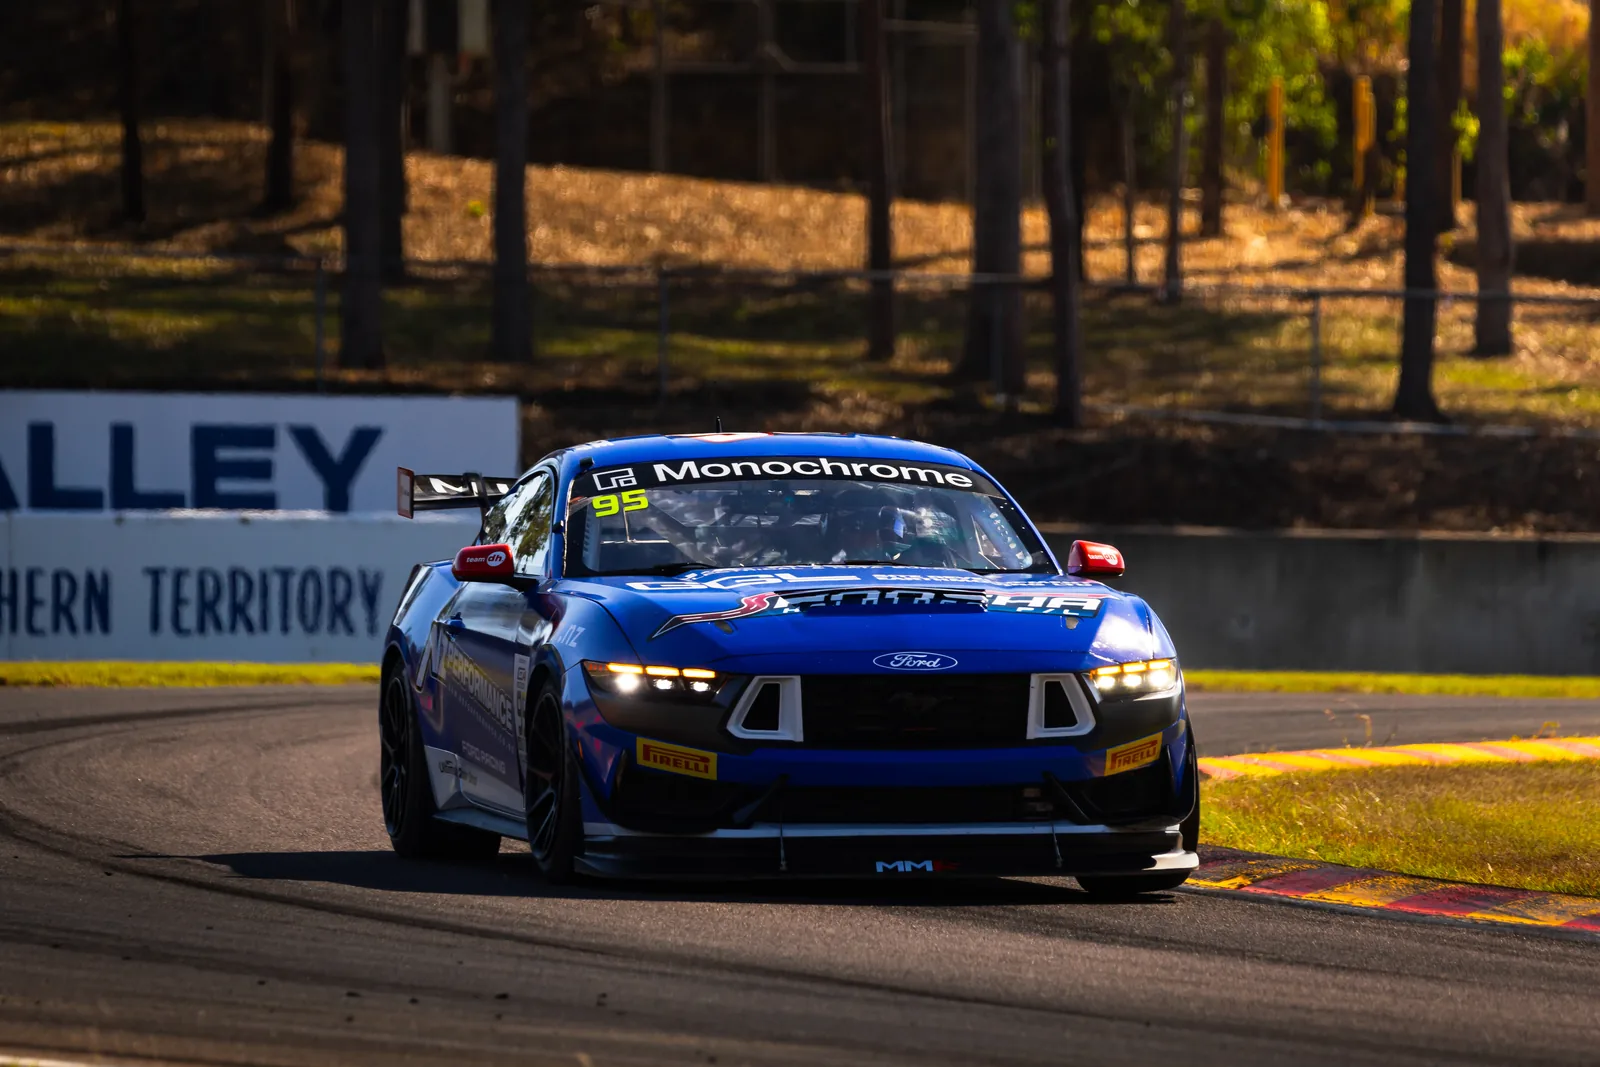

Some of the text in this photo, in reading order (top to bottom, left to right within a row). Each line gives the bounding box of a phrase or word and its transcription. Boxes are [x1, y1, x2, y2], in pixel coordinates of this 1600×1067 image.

[653, 457, 974, 488] Monochrome
[592, 488, 649, 517] 95
[143, 566, 384, 638] TERRITORY
[890, 654, 941, 668] Ford
[642, 744, 711, 774] PIRELLI
[1110, 739, 1158, 770] PIRELLI
